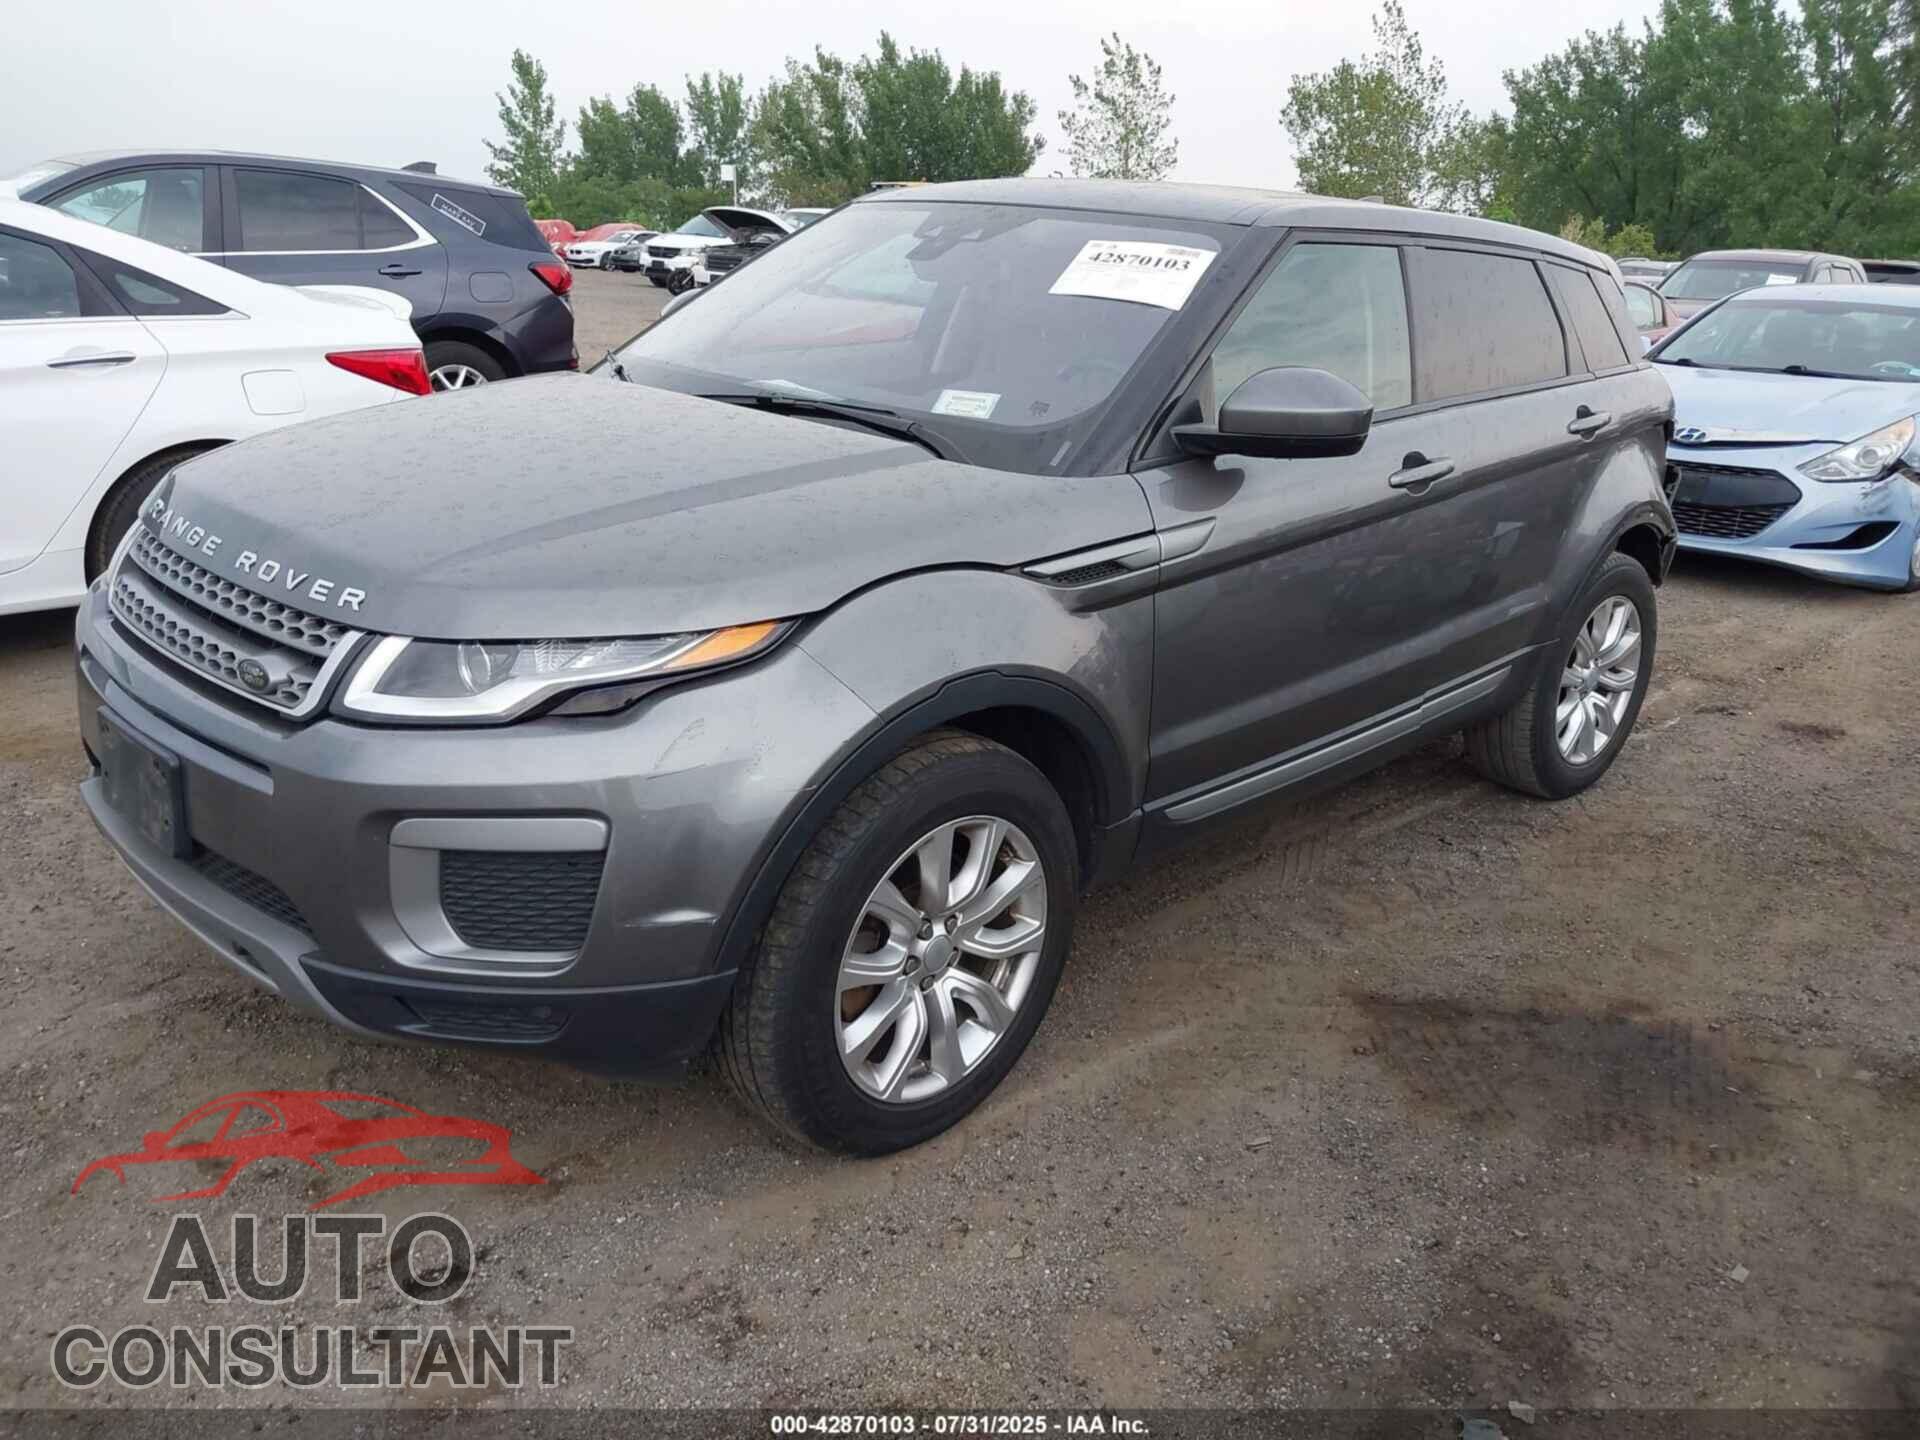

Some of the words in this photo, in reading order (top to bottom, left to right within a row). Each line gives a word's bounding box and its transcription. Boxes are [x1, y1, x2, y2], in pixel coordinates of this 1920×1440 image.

[1088, 251, 1191, 271] 42870103
[150, 499, 223, 556] RANGE
[235, 550, 366, 611] ROVER
